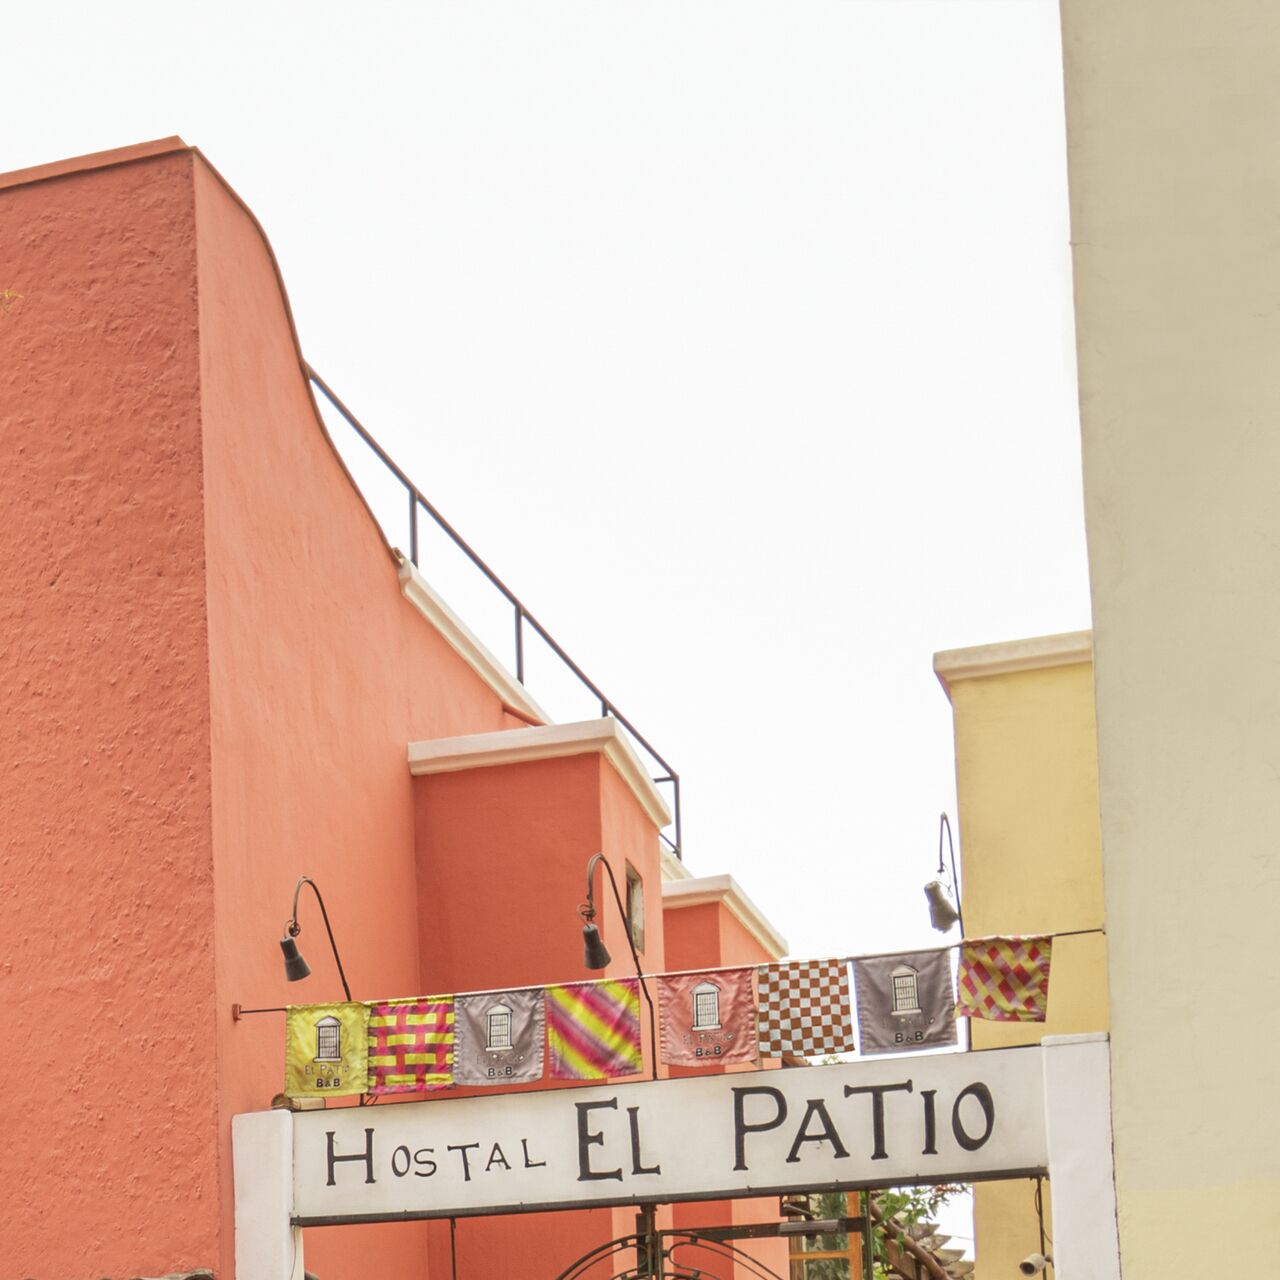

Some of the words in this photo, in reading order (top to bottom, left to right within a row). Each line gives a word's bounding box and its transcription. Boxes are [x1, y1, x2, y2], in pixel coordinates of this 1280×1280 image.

[325, 1127, 547, 1187] HOSTAL
[575, 1096, 661, 1183] EL
[732, 1078, 996, 1172] PATIO
